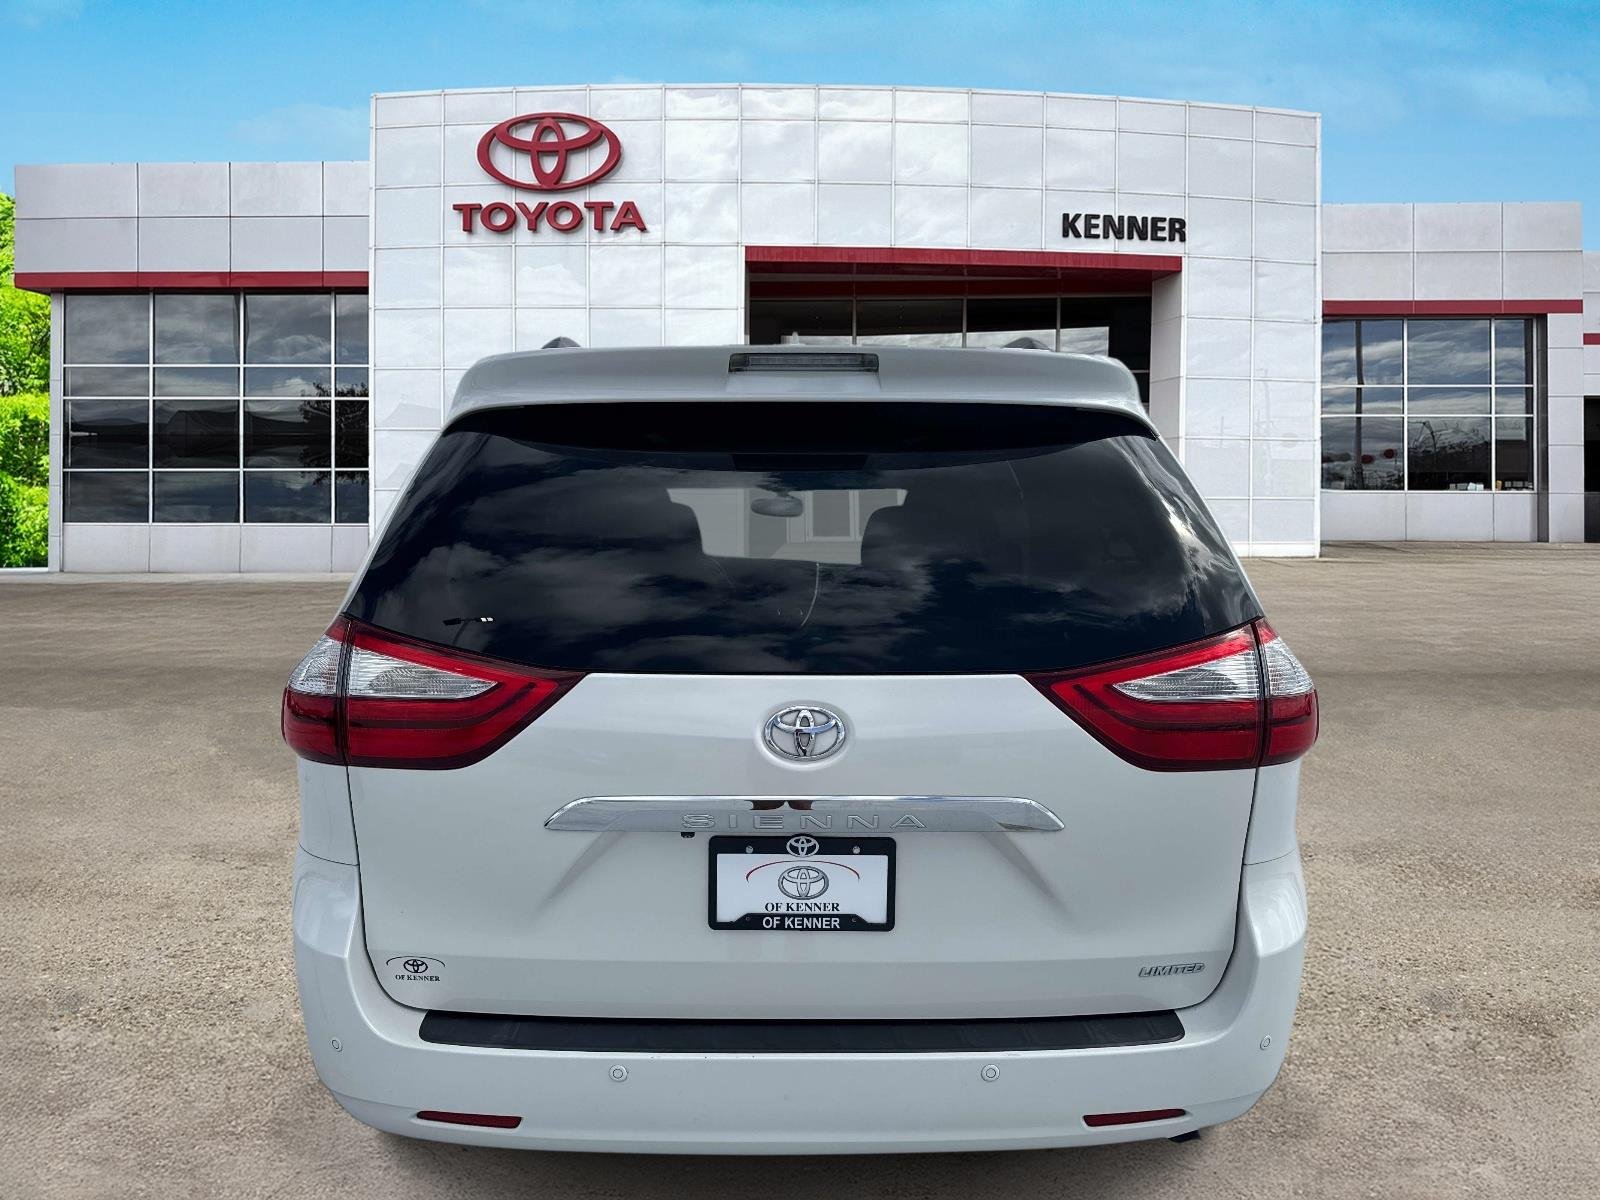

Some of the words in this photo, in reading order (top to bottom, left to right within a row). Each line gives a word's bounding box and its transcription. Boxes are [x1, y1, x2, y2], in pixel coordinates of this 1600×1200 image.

[452, 201, 647, 233] TOYOTA
[1062, 213, 1187, 242] KENNER
[681, 814, 927, 830] SIENNA
[764, 902, 783, 912] OF
[785, 902, 840, 912] KENNER
[762, 916, 781, 929] OF
[784, 916, 841, 929] KENNER
[407, 974, 441, 982] KENNER
[1138, 962, 1206, 978] LIMITED
